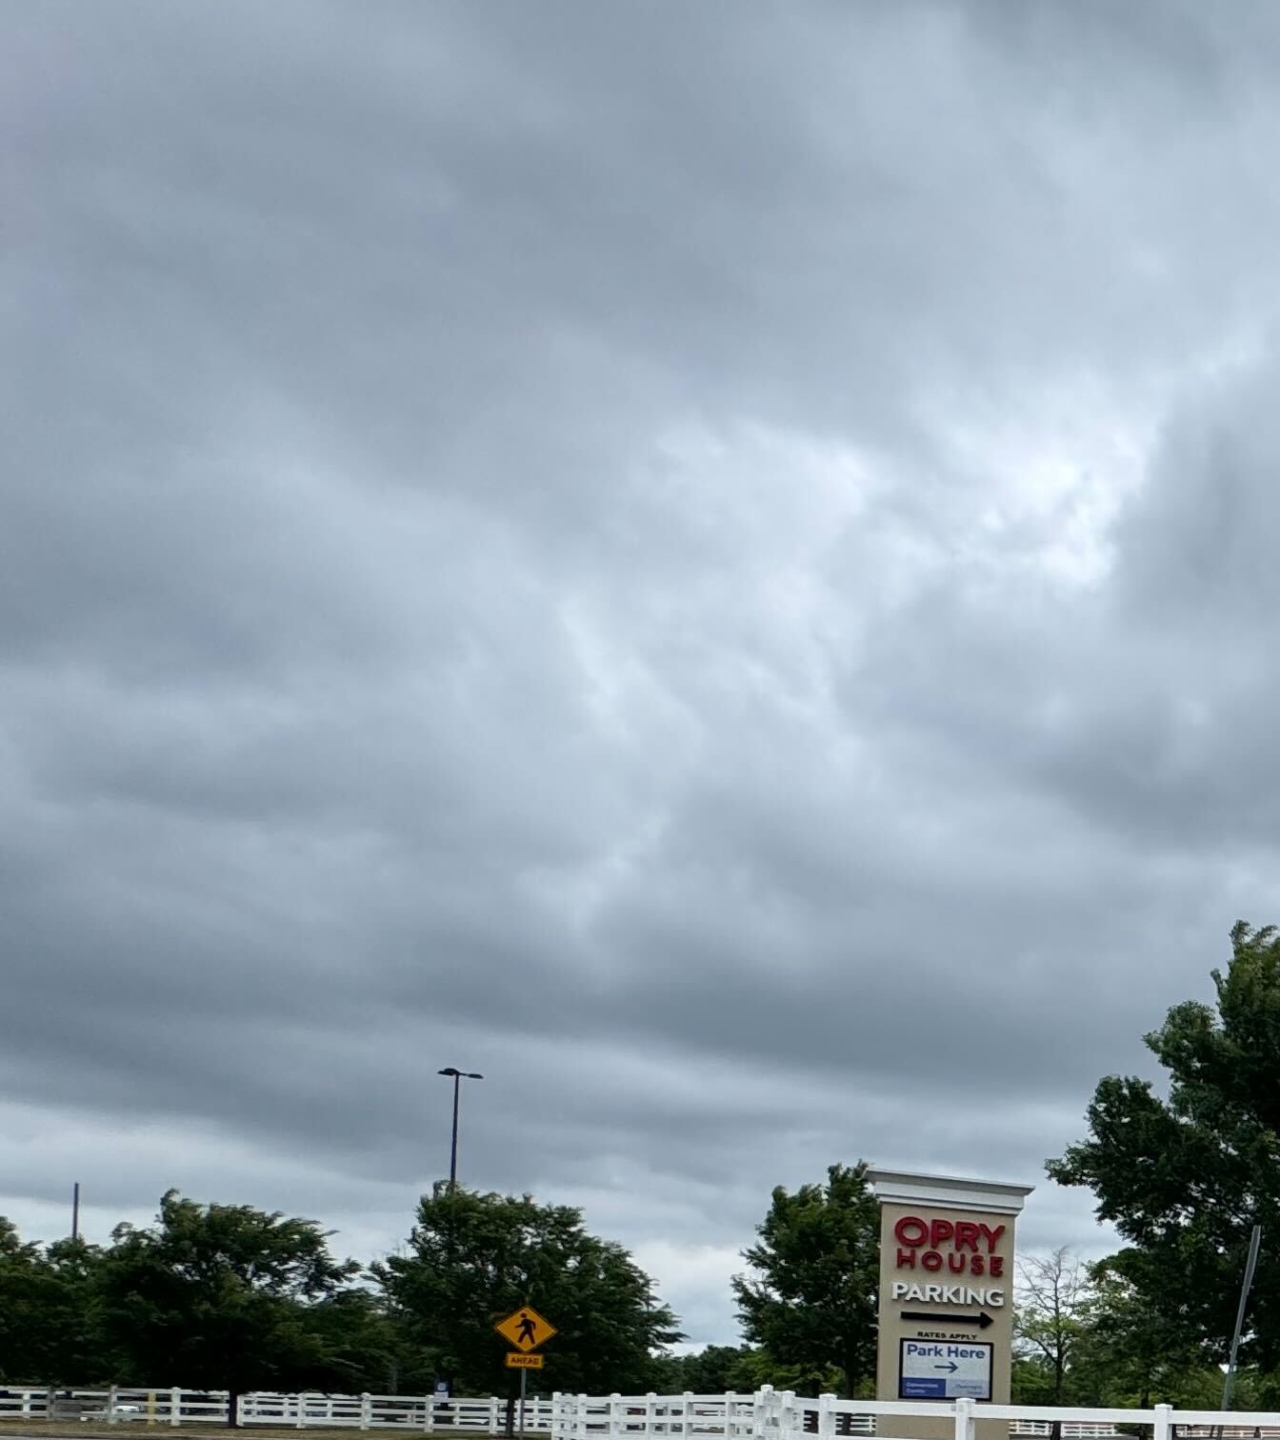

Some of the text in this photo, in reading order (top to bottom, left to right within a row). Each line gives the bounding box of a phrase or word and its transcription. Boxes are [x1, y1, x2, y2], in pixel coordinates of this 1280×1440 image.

[895, 1216, 1006, 1254] OPRY
[897, 1248, 1004, 1278] HOUSE
[891, 1281, 1005, 1307] PARKING
[917, 1331, 947, 1339] RATES
[906, 1343, 986, 1359] Park Here
